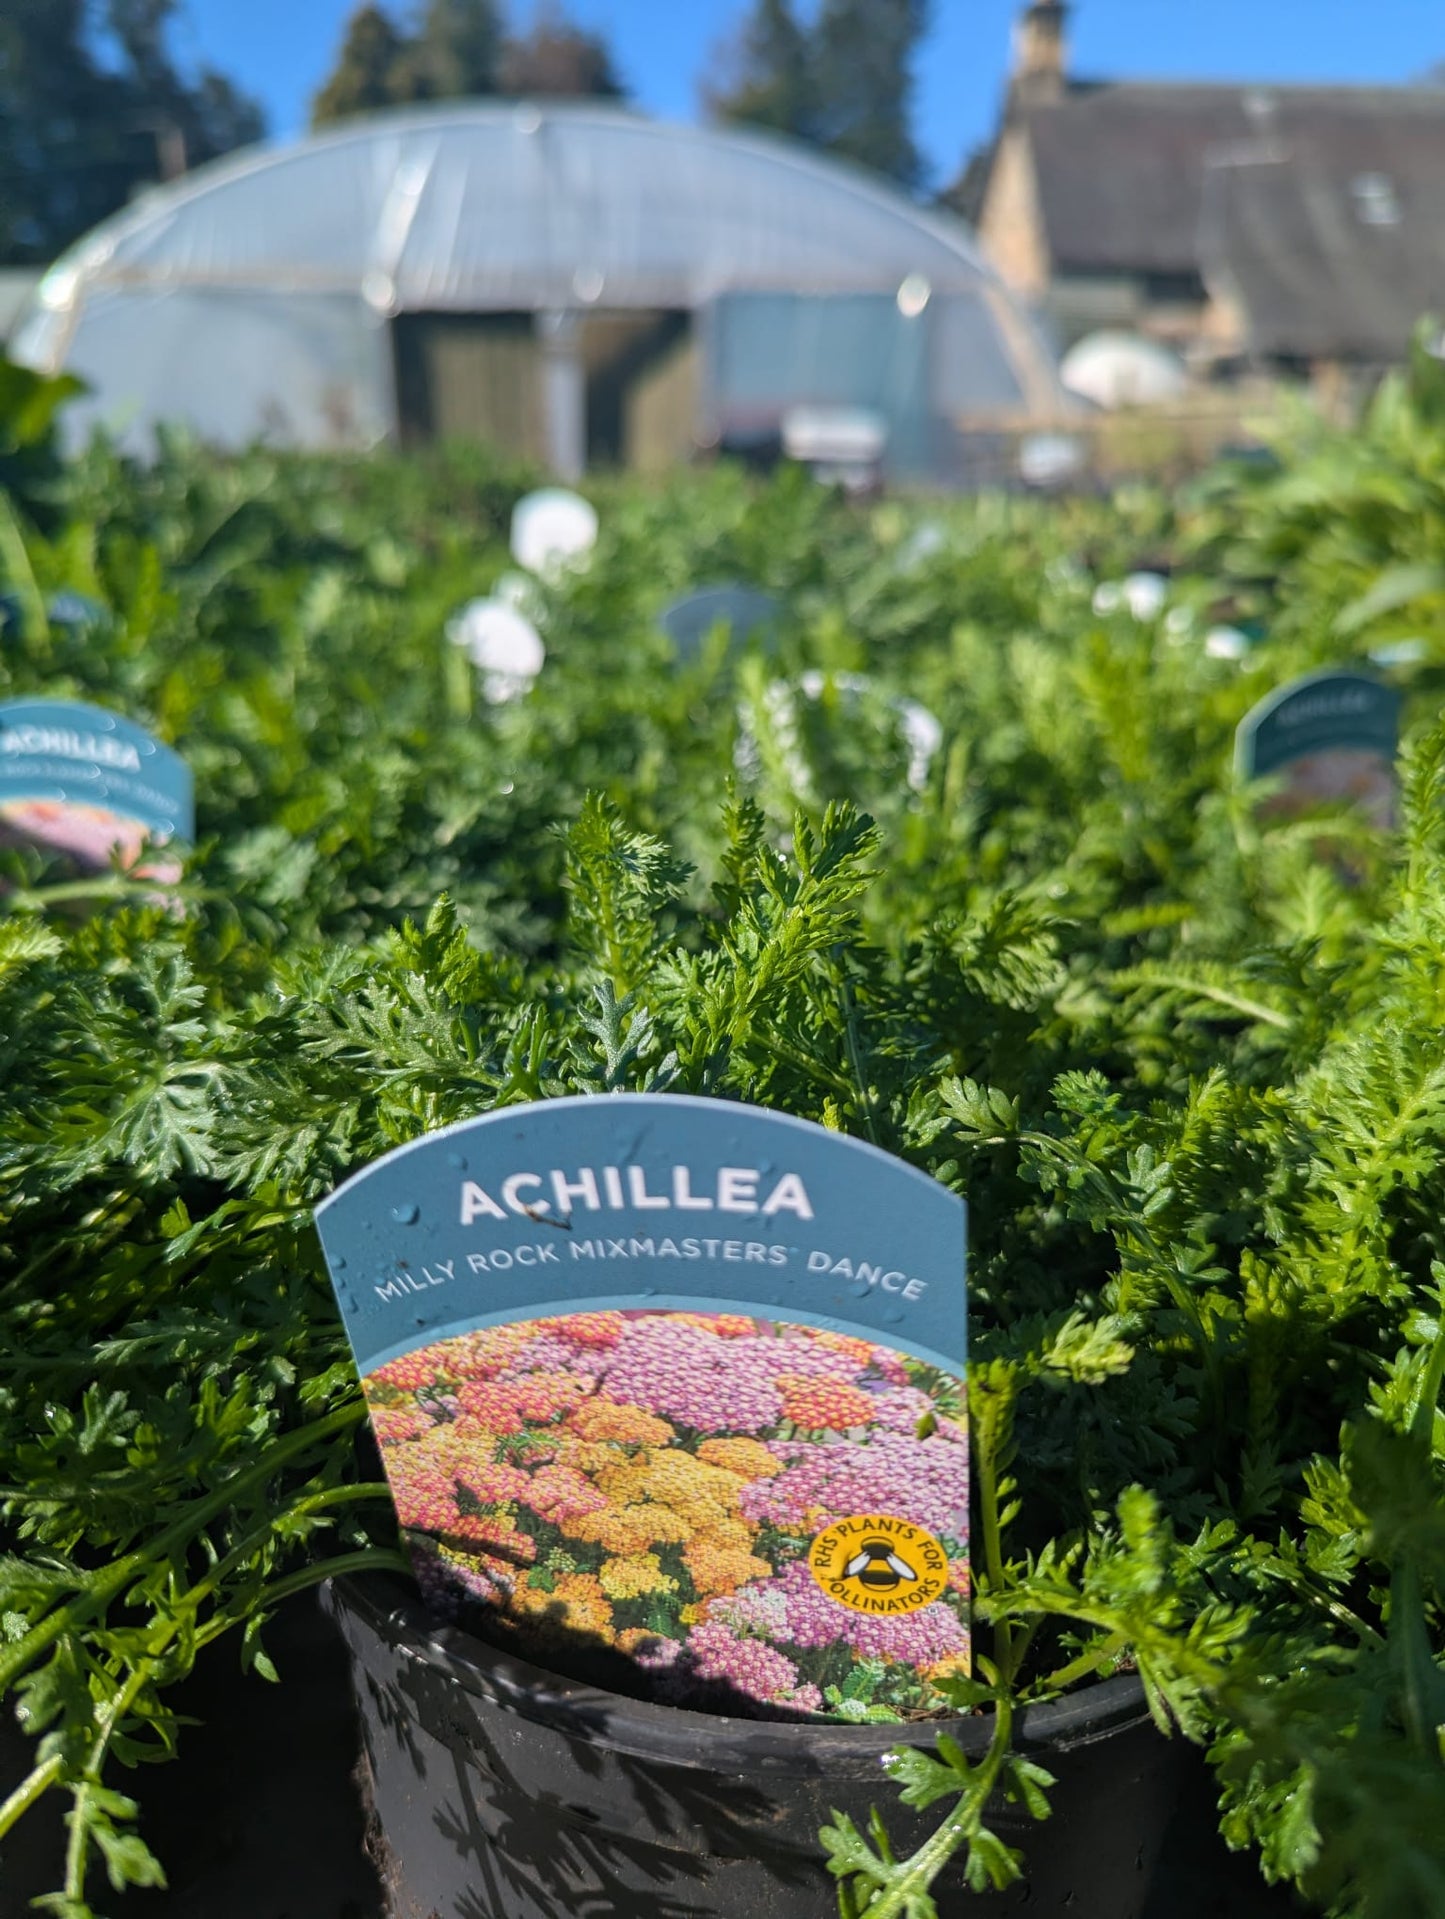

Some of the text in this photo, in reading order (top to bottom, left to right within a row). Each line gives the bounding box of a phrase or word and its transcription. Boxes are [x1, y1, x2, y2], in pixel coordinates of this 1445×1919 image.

[1, 724, 141, 773] ACHILLEA
[459, 1166, 814, 1225] ACHILLEA
[374, 1238, 928, 1303] MILLY ROCK MIXMASTERS DANCE
[815, 1536, 838, 1567] RHS
[836, 1518, 918, 1540] PLANTS
[917, 1540, 943, 1570] FOR
